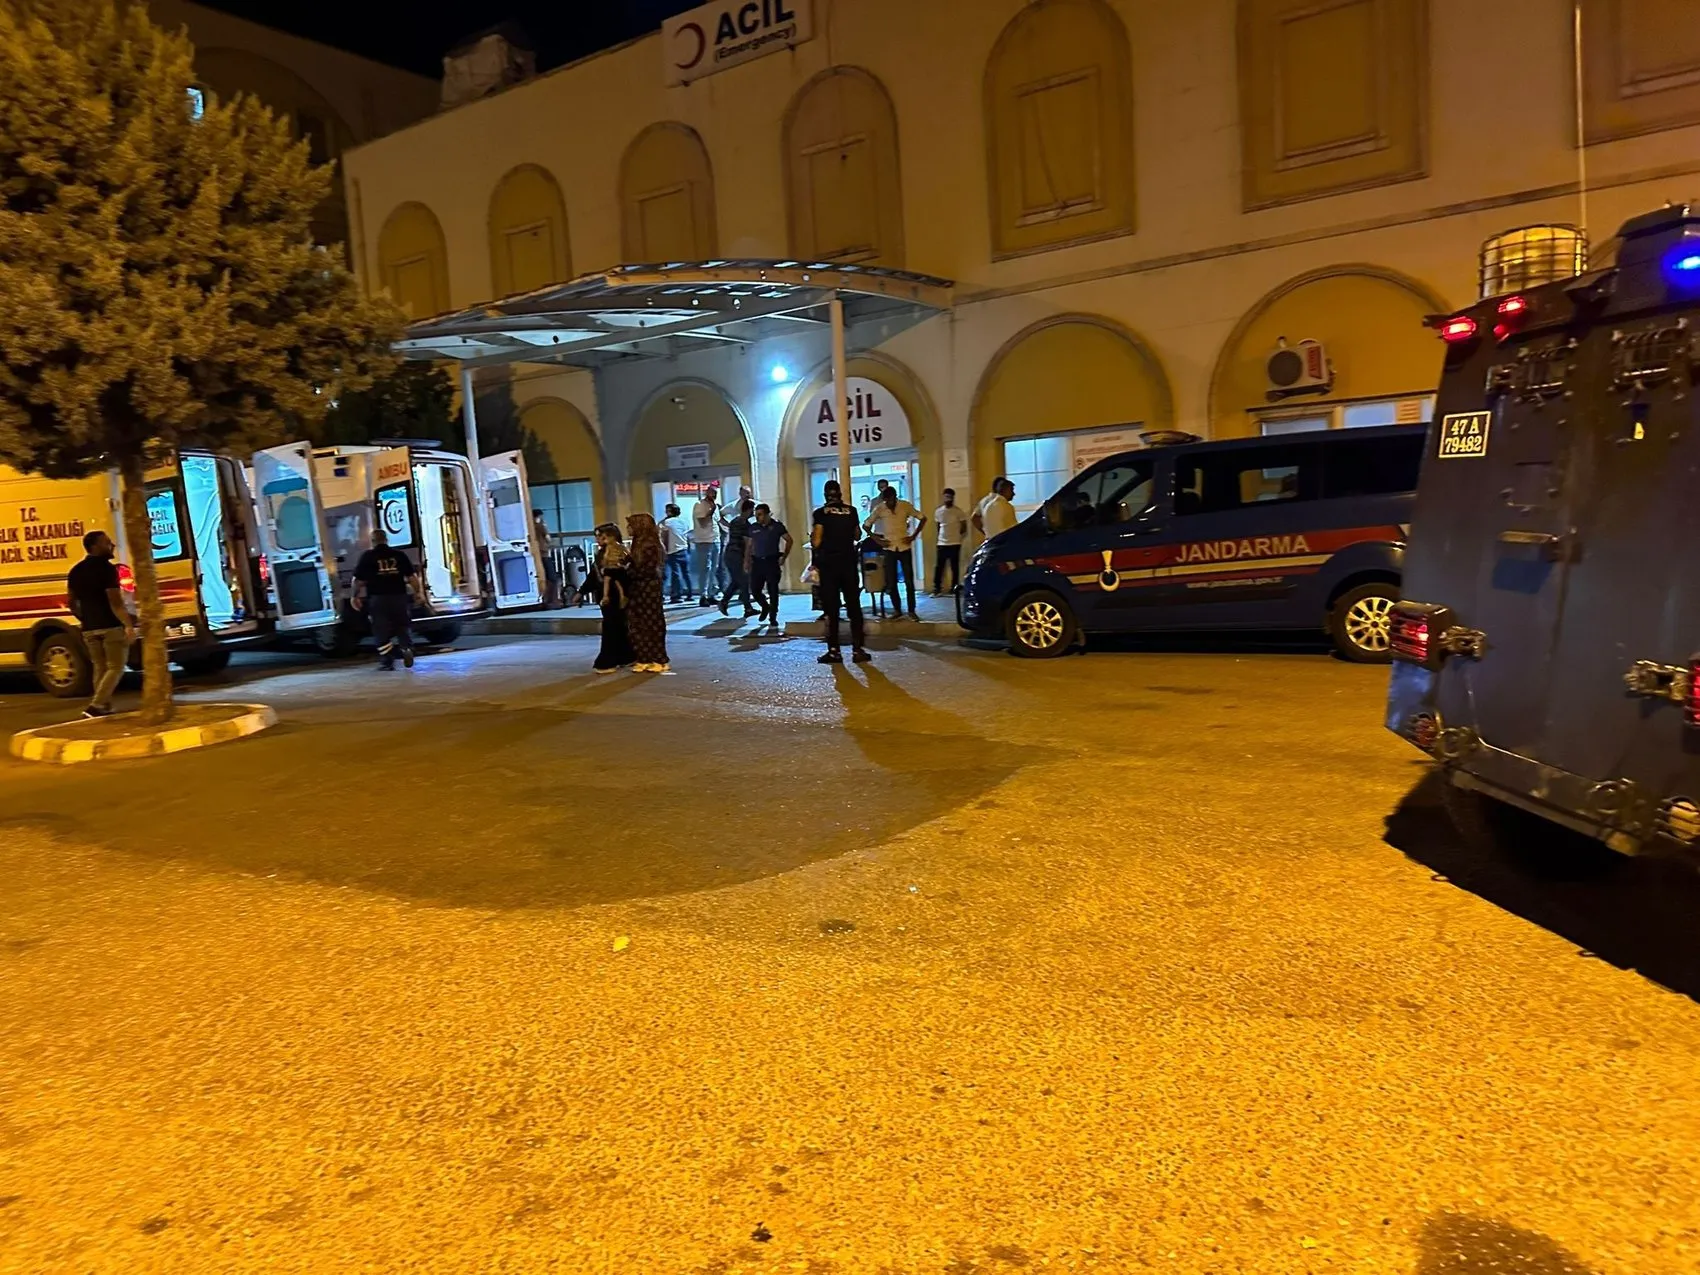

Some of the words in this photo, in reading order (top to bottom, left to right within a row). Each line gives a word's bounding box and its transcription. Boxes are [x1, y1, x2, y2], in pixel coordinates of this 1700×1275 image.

[818, 423, 883, 447] SEVİS
[1450, 418, 1468, 436] 47
[1468, 416, 1480, 435] A
[1444, 435, 1483, 453] 79482
[388, 509, 404, 524] 112
[24, 518, 84, 541] BAKANLIĞI
[1, 545, 24, 564] ACİL
[27, 542, 68, 561] SAĞLIK
[1175, 534, 1311, 563] JANDARMA
[377, 557, 398, 571] 112
